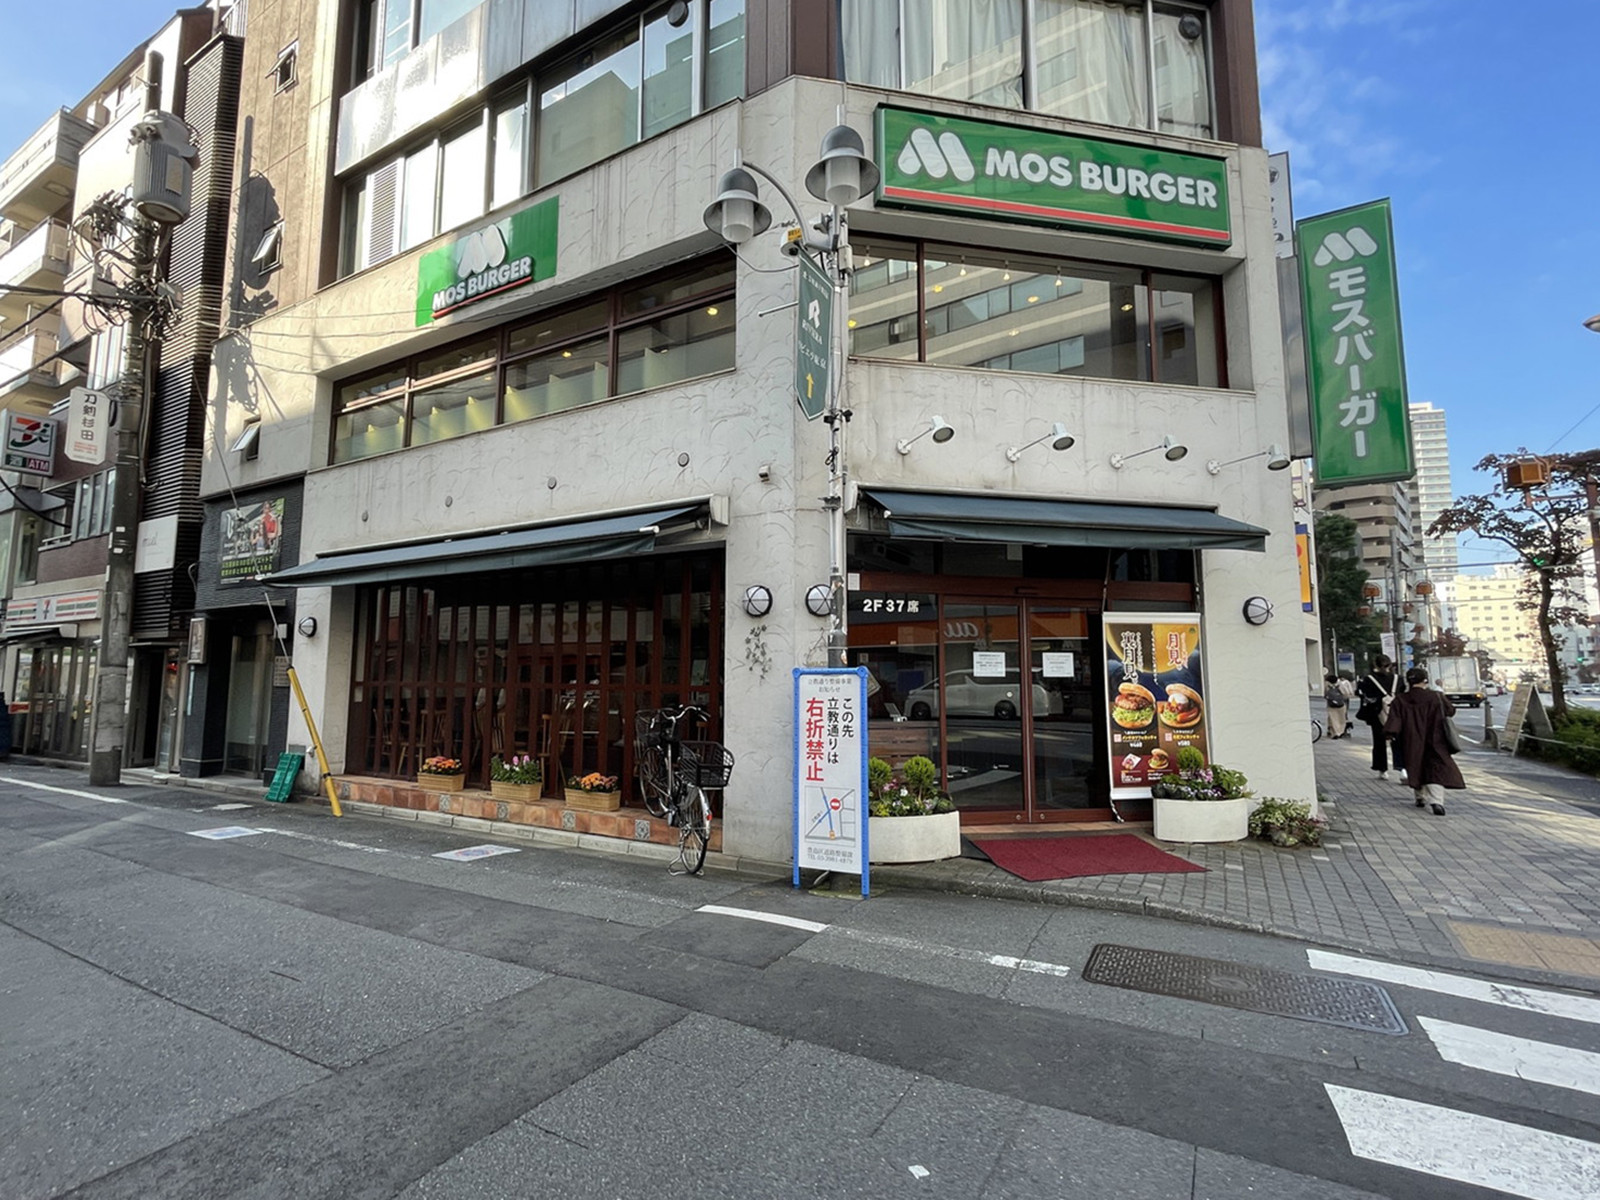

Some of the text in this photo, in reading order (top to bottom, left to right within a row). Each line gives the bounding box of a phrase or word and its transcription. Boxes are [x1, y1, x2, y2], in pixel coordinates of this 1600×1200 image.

[985, 147, 1073, 187] MOS
[1079, 161, 1218, 208] BURGER
[432, 256, 532, 311] MOS BURGER
[1329, 266, 1378, 458] モスバーガー
[80, 393, 98, 441] 刀剣杉田
[28, 459, 50, 472] ATM
[862, 599, 883, 613] 2F
[806, 697, 825, 782] 右折禁止
[827, 697, 840, 765] 立教通りは
[841, 698, 854, 738] この先
